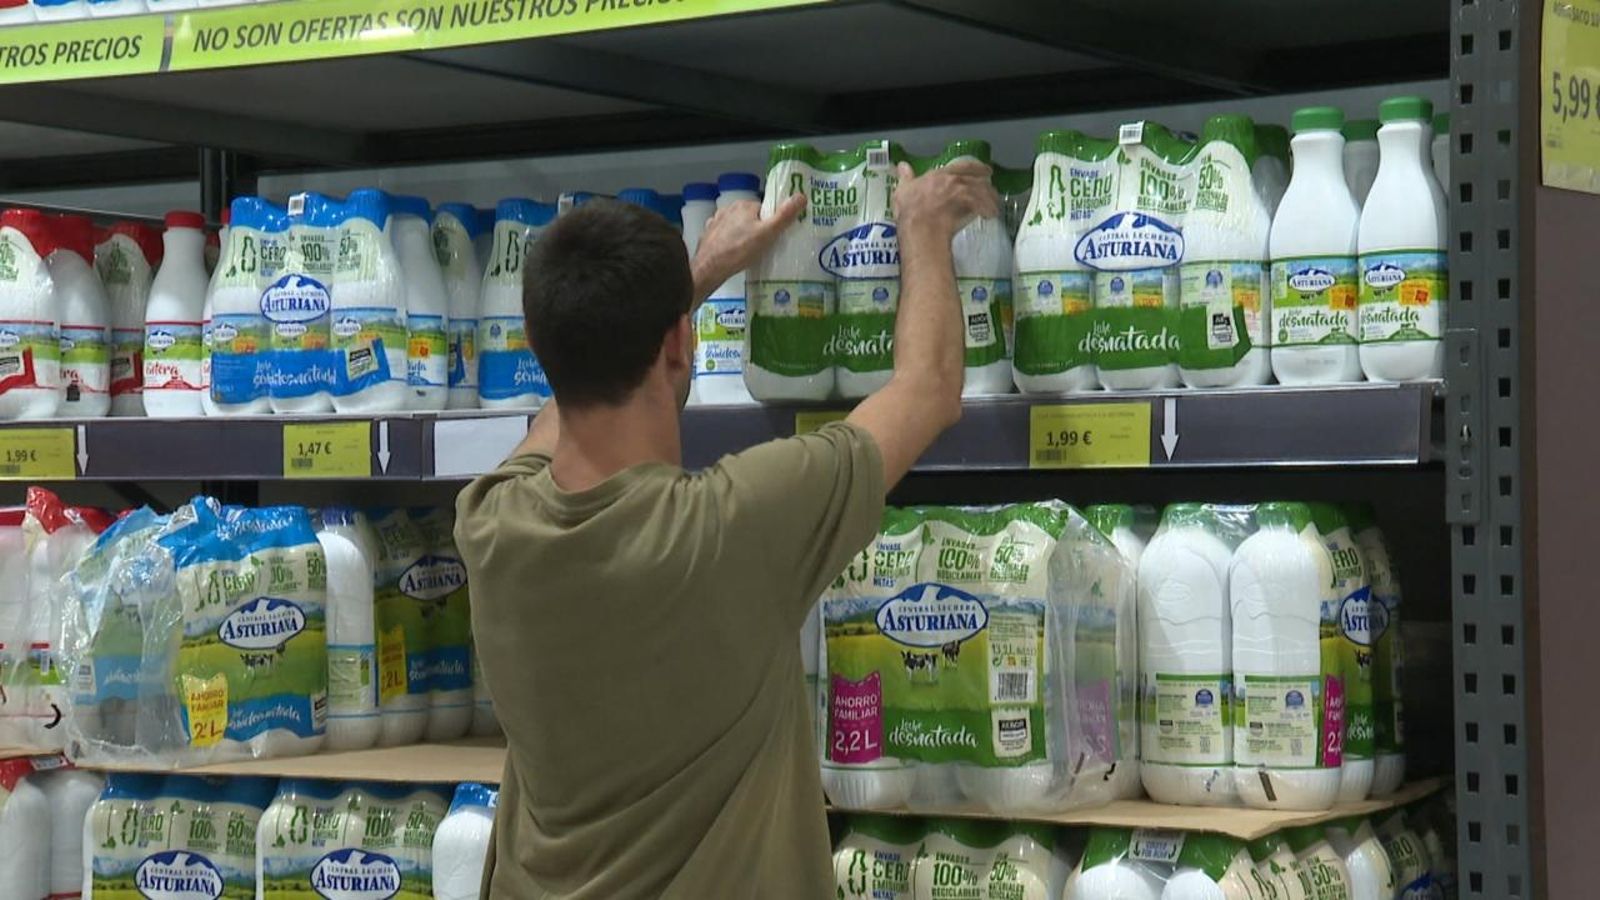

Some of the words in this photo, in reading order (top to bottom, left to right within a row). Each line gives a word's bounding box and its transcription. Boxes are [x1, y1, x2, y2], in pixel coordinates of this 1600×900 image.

[194, 28, 230, 53] NO
[233, 22, 283, 49] SON
[288, 10, 389, 44] OFERTAS
[396, 6, 443, 32] SON
[449, 0, 578, 29] NUESTROS
[52, 35, 143, 64] PRECIOS
[1552, 70, 1591, 124] 5,99
[1070, 167, 1099, 178] ENVASE
[1140, 158, 1178, 181] ENVASES
[1199, 164, 1224, 190] 50%
[811, 176, 838, 189] ENVASE
[1070, 174, 1112, 198] CERO
[1140, 170, 1185, 201] 100%
[811, 186, 857, 206] CERO
[812, 204, 858, 217] EMISIONES
[1133, 231, 1176, 242] LECHERA
[1082, 238, 1178, 260] ASTURIANA
[263, 297, 326, 313] ASTURIANA
[1279, 310, 1349, 328] desnatada
[1078, 325, 1182, 353] desnatada
[1046, 431, 1078, 447] 1,99
[1083, 430, 1093, 445] €
[6, 450, 27, 464] 1,99
[29, 449, 36, 463] €
[298, 442, 321, 457] 1,47
[324, 441, 332, 455] €
[941, 538, 976, 550] ENVASES
[874, 550, 915, 568] CERO
[939, 548, 980, 570] 100%
[899, 605, 934, 613] CENTRAL
[938, 604, 977, 612] LECHERA
[223, 617, 298, 641] ASTURIANA
[883, 607, 978, 631] ASTURIANA
[835, 693, 878, 706] AHORRO
[834, 706, 878, 721] FAMILIAR
[835, 730, 861, 755] 2,2
[864, 728, 878, 749] L
[889, 723, 979, 748] desnatada
[189, 820, 217, 840] 100%
[874, 850, 900, 861] ENVASE
[935, 851, 971, 864] ENVASES
[315, 865, 396, 892] ASTURIANA
[872, 860, 911, 880] CERO
[933, 863, 978, 886] 100%
[990, 861, 1018, 881] 50%
[1312, 862, 1340, 887] 50%
[140, 866, 216, 897] ASTURIANA
